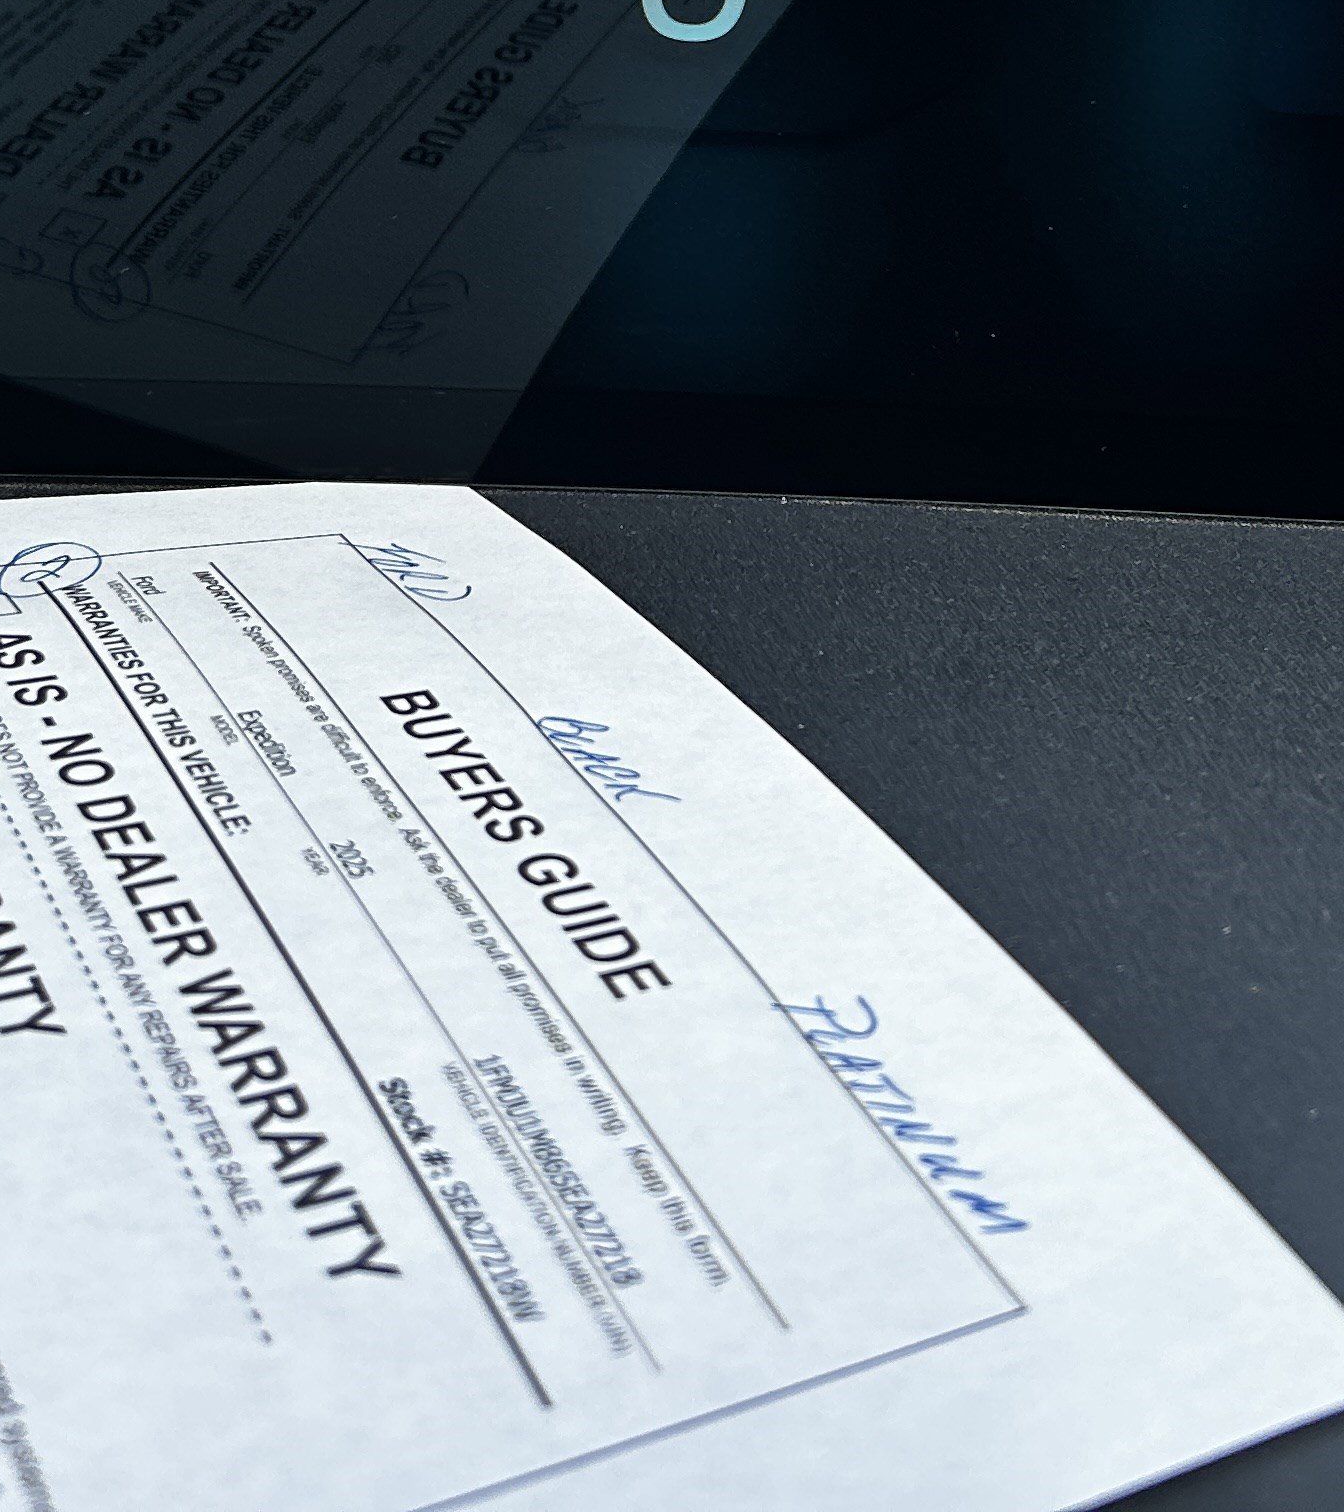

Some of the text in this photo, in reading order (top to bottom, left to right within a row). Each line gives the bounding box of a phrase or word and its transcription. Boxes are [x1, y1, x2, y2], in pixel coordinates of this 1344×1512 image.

[5, 674, 68, 706] IS
[60, 580, 250, 836] WARRANTIES FOR THIS VEHICLE:
[39, 731, 115, 787] NO
[133, 574, 166, 594] Ford
[236, 708, 297, 777] Expedition
[328, 838, 375, 879] 2025
[194, 568, 251, 624] IMPORTANT:
[241, 624, 279, 658] Spoken
[265, 658, 315, 703] promises
[304, 703, 329, 722] are
[319, 722, 363, 764] difficult
[349, 761, 369, 776] to
[359, 776, 403, 823] enforce.
[397, 827, 431, 853] Ask
[417, 851, 444, 875] the
[434, 875, 478, 919] dealer
[9, 771, 63, 834] PROVIDE
[43, 834, 68, 847] A
[378, 688, 672, 1000] BUYERS GUIDE
[51, 845, 117, 931] WARRANTY
[74, 793, 217, 967] DEALER
[97, 933, 135, 973] FOR
[116, 972, 157, 1006] ANY
[137, 1008, 198, 1093] REPAIRS
[177, 967, 402, 1278] WARRANTY
[178, 1093, 233, 1161] AFTER
[376, 1076, 436, 1146] Stock
[213, 1160, 263, 1221] SALE.
